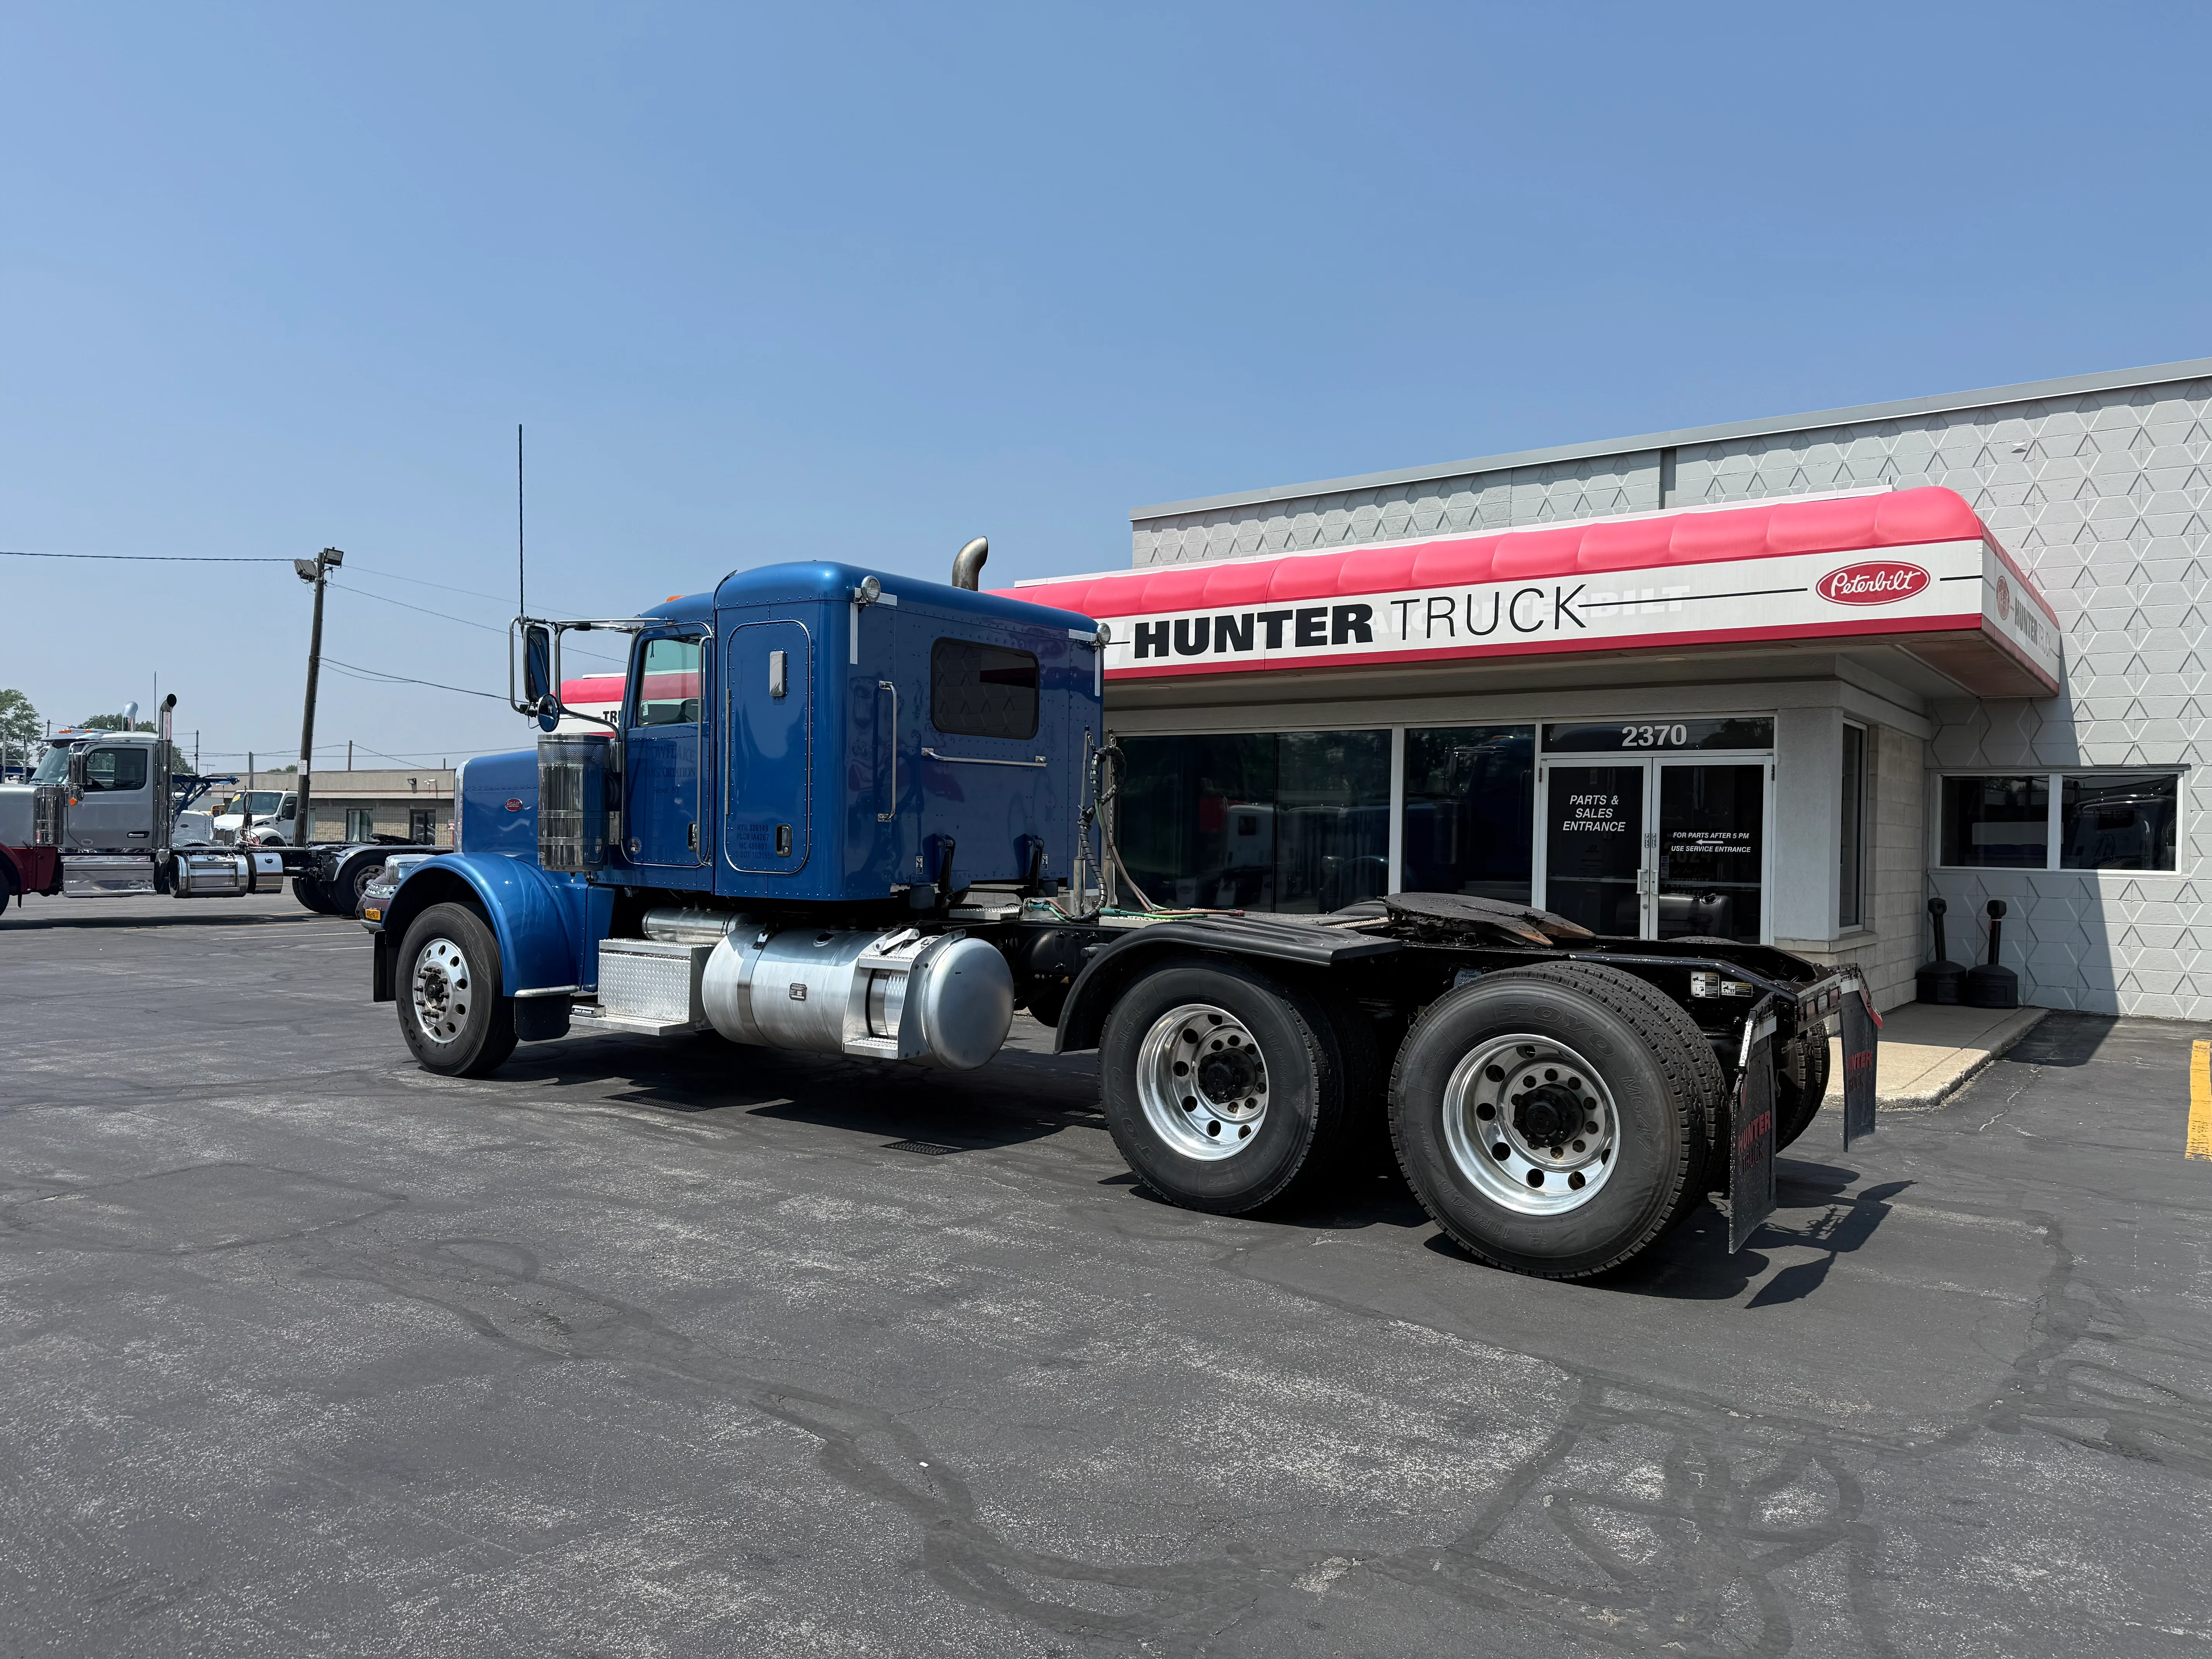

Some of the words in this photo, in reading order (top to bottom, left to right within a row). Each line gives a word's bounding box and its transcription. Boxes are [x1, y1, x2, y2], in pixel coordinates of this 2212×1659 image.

[1831, 570, 1921, 597] Peterbilt
[1134, 603, 1374, 659] HUNTER
[1390, 584, 1587, 641] TRUCK
[2014, 597, 2037, 646] HUNTER
[2039, 623, 2051, 659] TRUCK
[1621, 724, 1687, 746] 2370
[1570, 795, 1607, 805] PARTS
[1611, 795, 1619, 805] &
[1575, 808, 1613, 818] SALES
[1563, 821, 1626, 831] ENTRANCE
[1502, 1002, 1616, 1056] TOYO
[1111, 1067, 1153, 1163] TOYO
[1738, 1110, 1771, 1154] HUNTER
[1743, 1140, 1764, 1177] TRUCK
